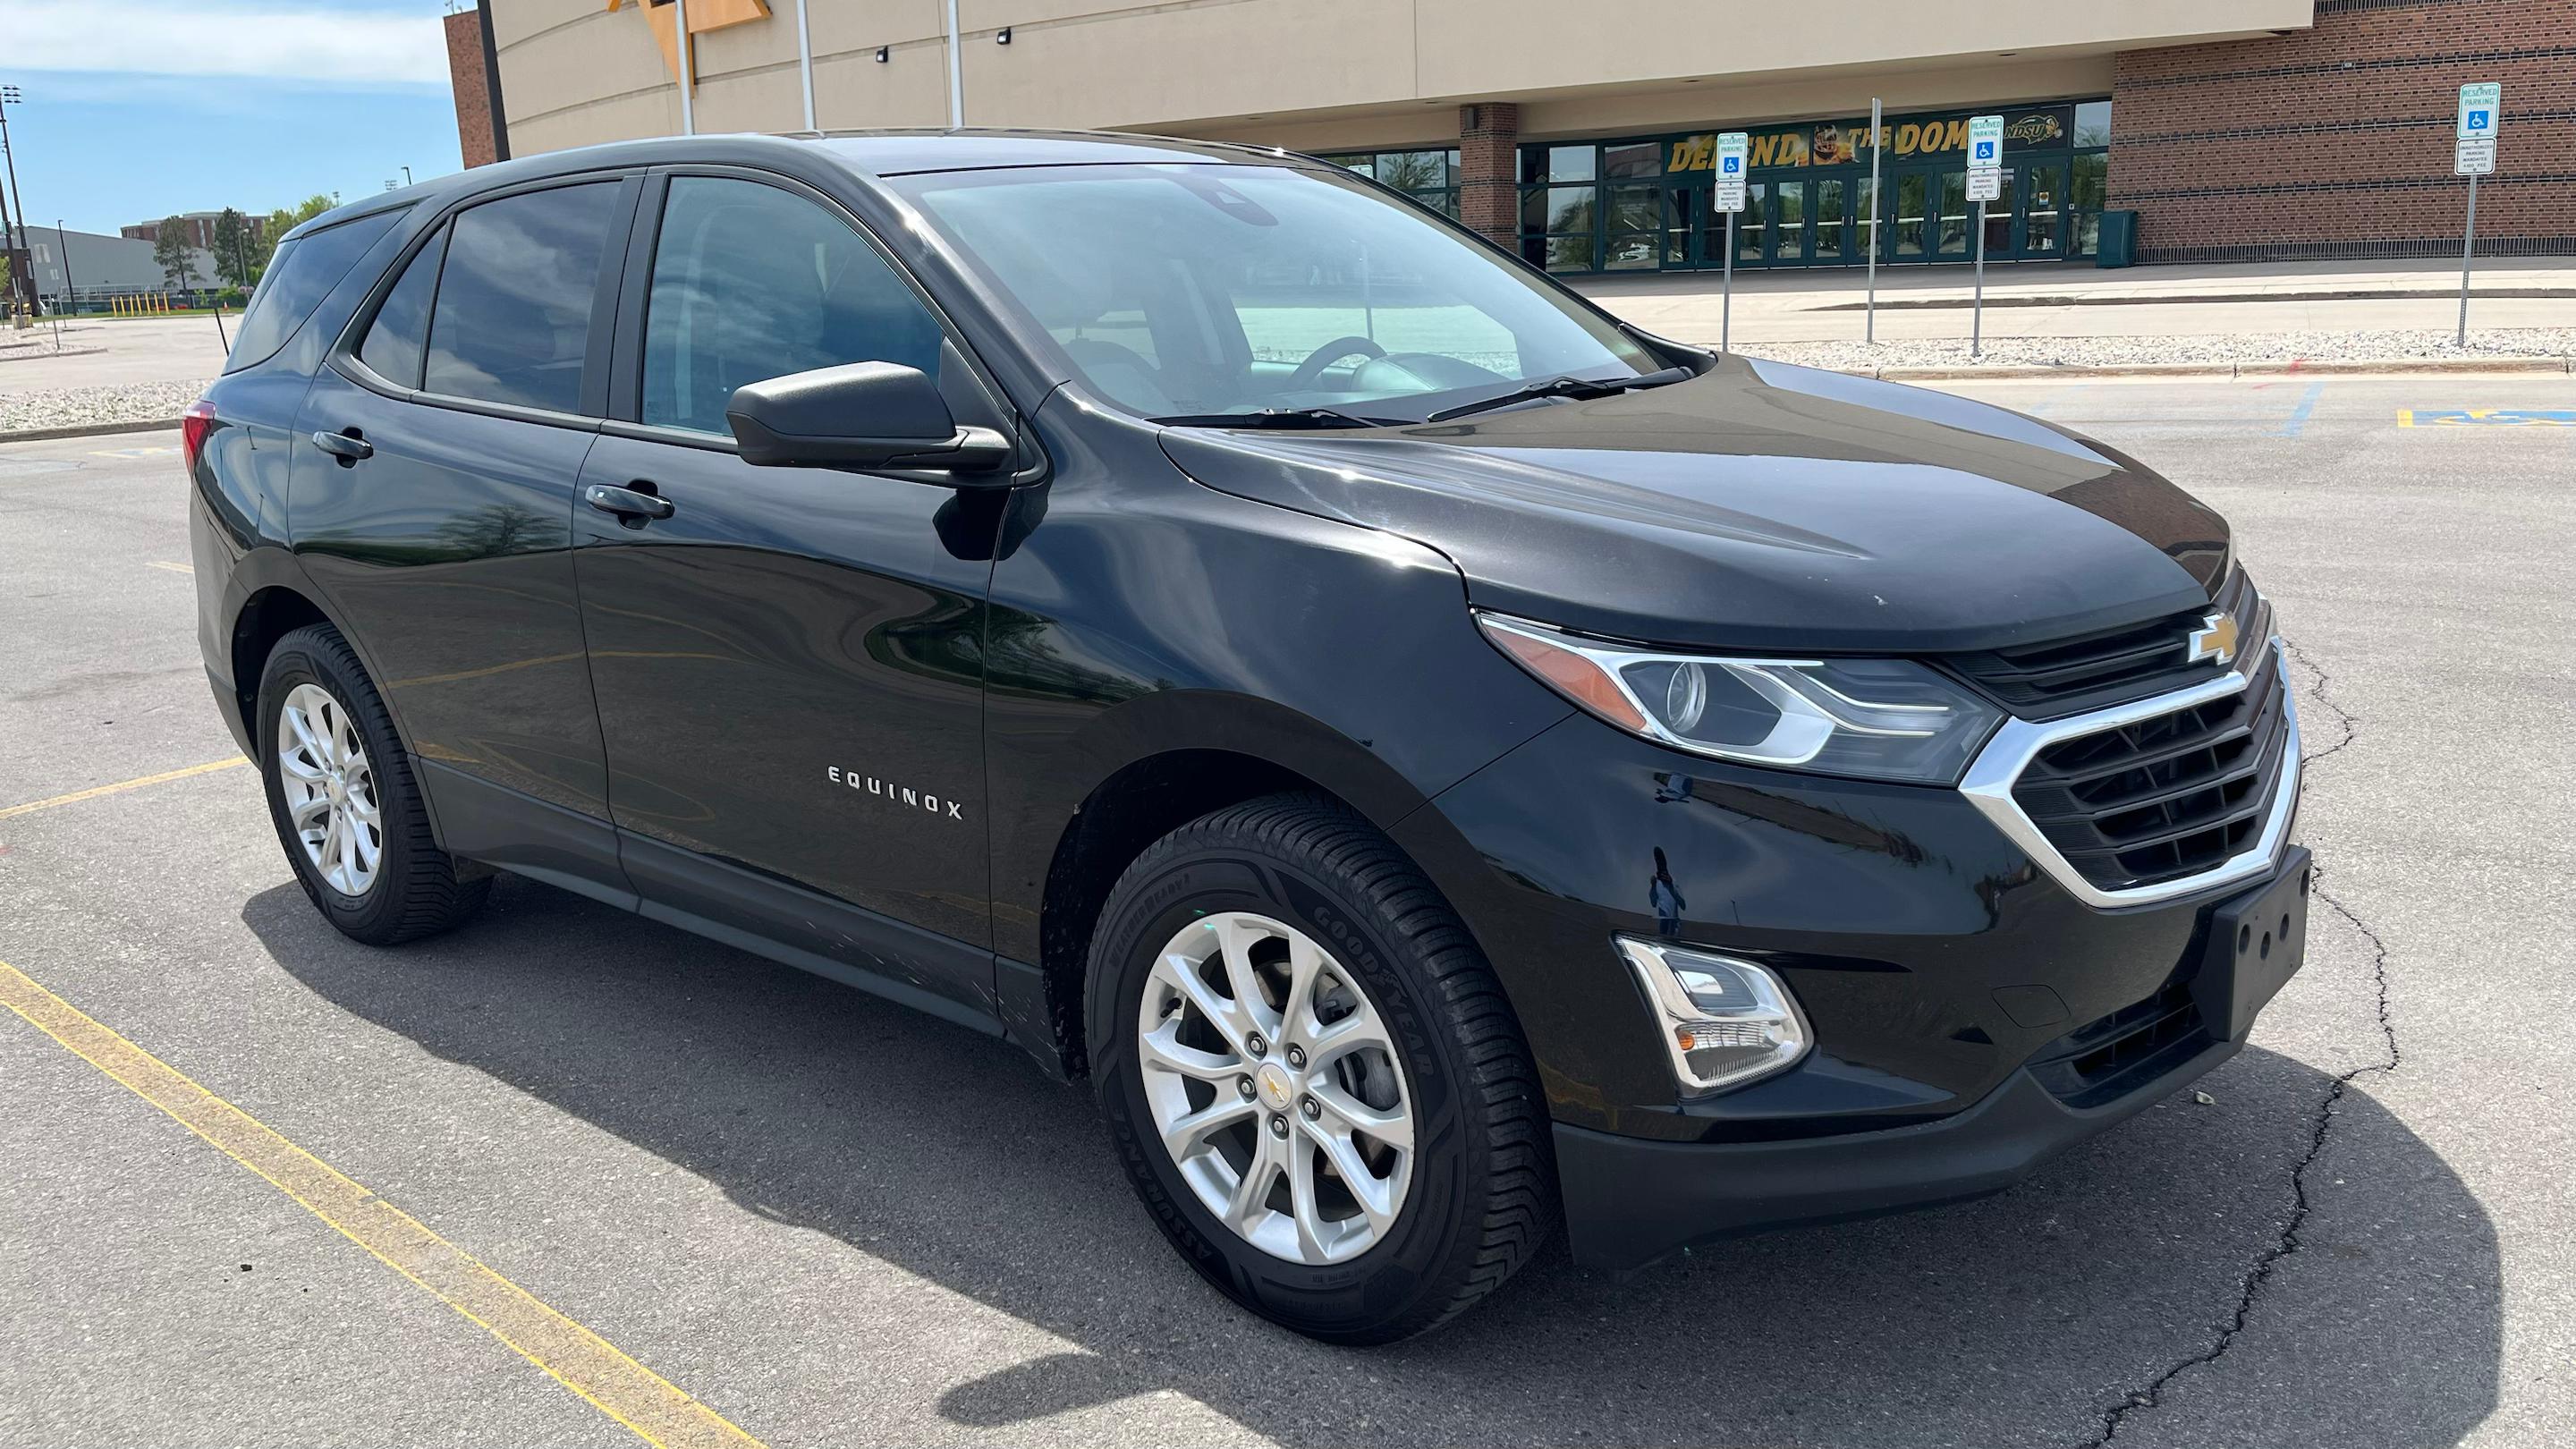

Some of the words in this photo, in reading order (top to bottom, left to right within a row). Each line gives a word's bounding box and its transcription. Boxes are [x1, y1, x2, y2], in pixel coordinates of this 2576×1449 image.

[2462, 89, 2497, 97] RESERVED
[2004, 123, 2045, 140] NDSU
[1667, 134, 1801, 172] DEND
[827, 766, 962, 820] EQUINOX
[1313, 906, 1435, 1077] GOODYEAR
